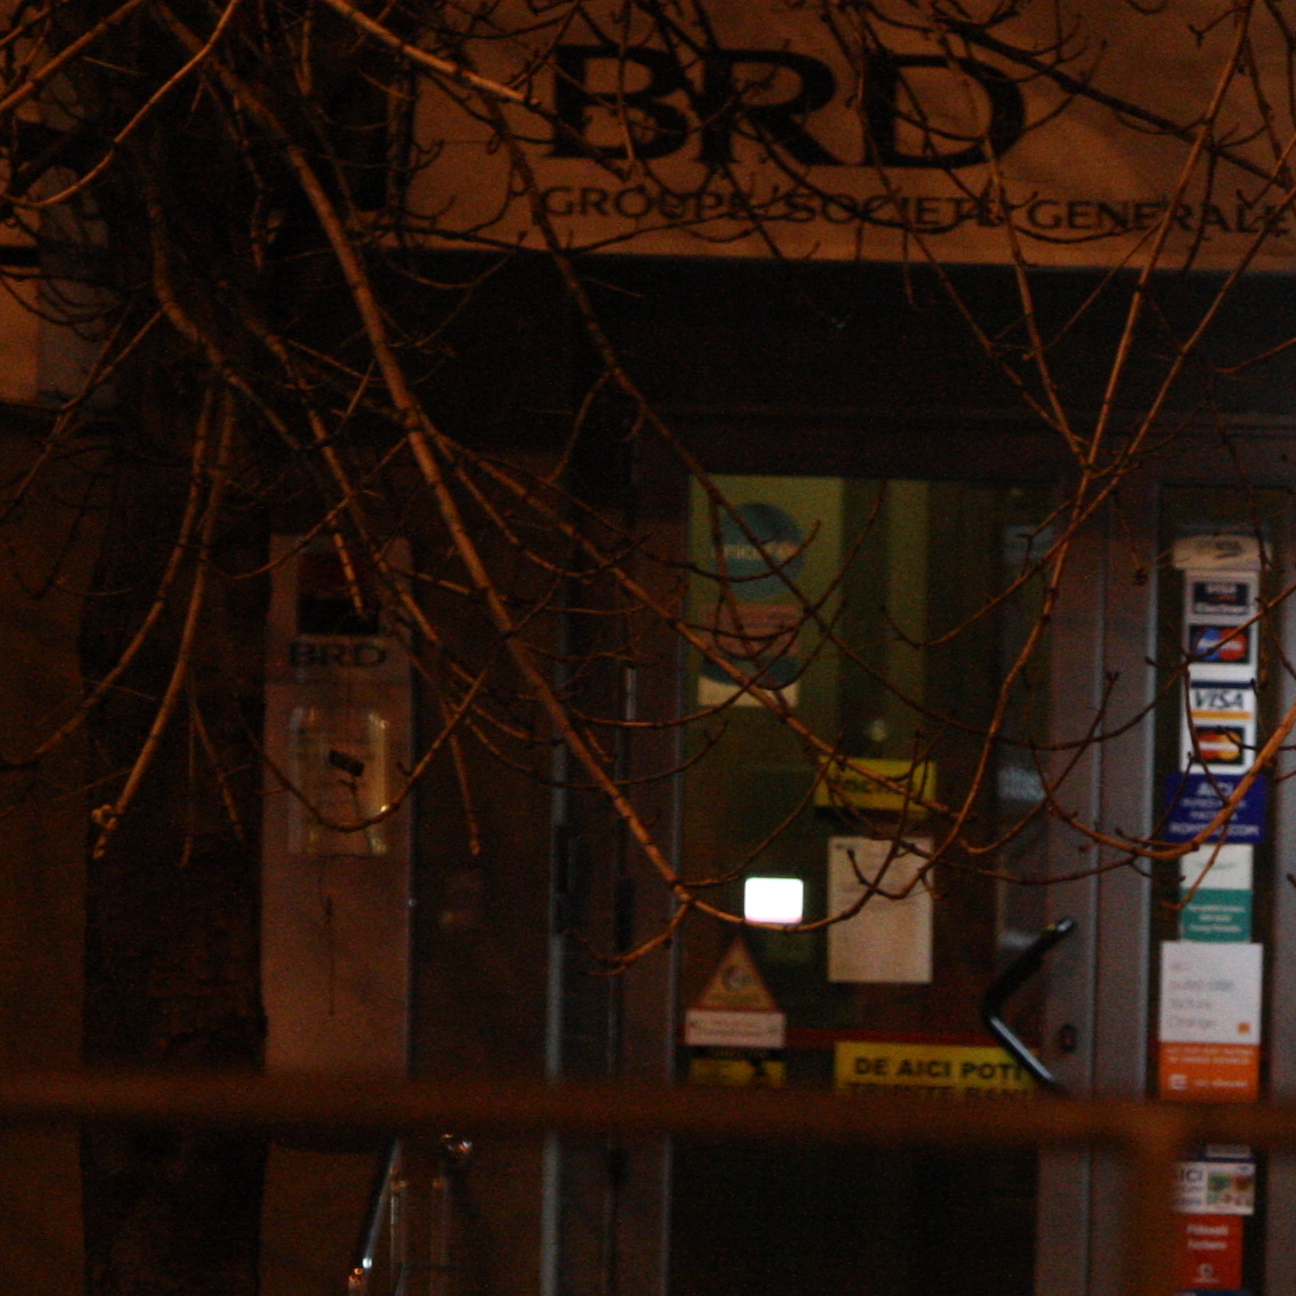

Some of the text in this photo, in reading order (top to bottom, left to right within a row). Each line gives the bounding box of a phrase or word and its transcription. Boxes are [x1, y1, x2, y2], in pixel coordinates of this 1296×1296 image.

[547, 44, 1025, 168] BRD
[540, 185, 754, 222] GROUPE
[289, 641, 387, 668] BRD
[854, 1056, 889, 1076] DE
[896, 1058, 951, 1078] AICI
